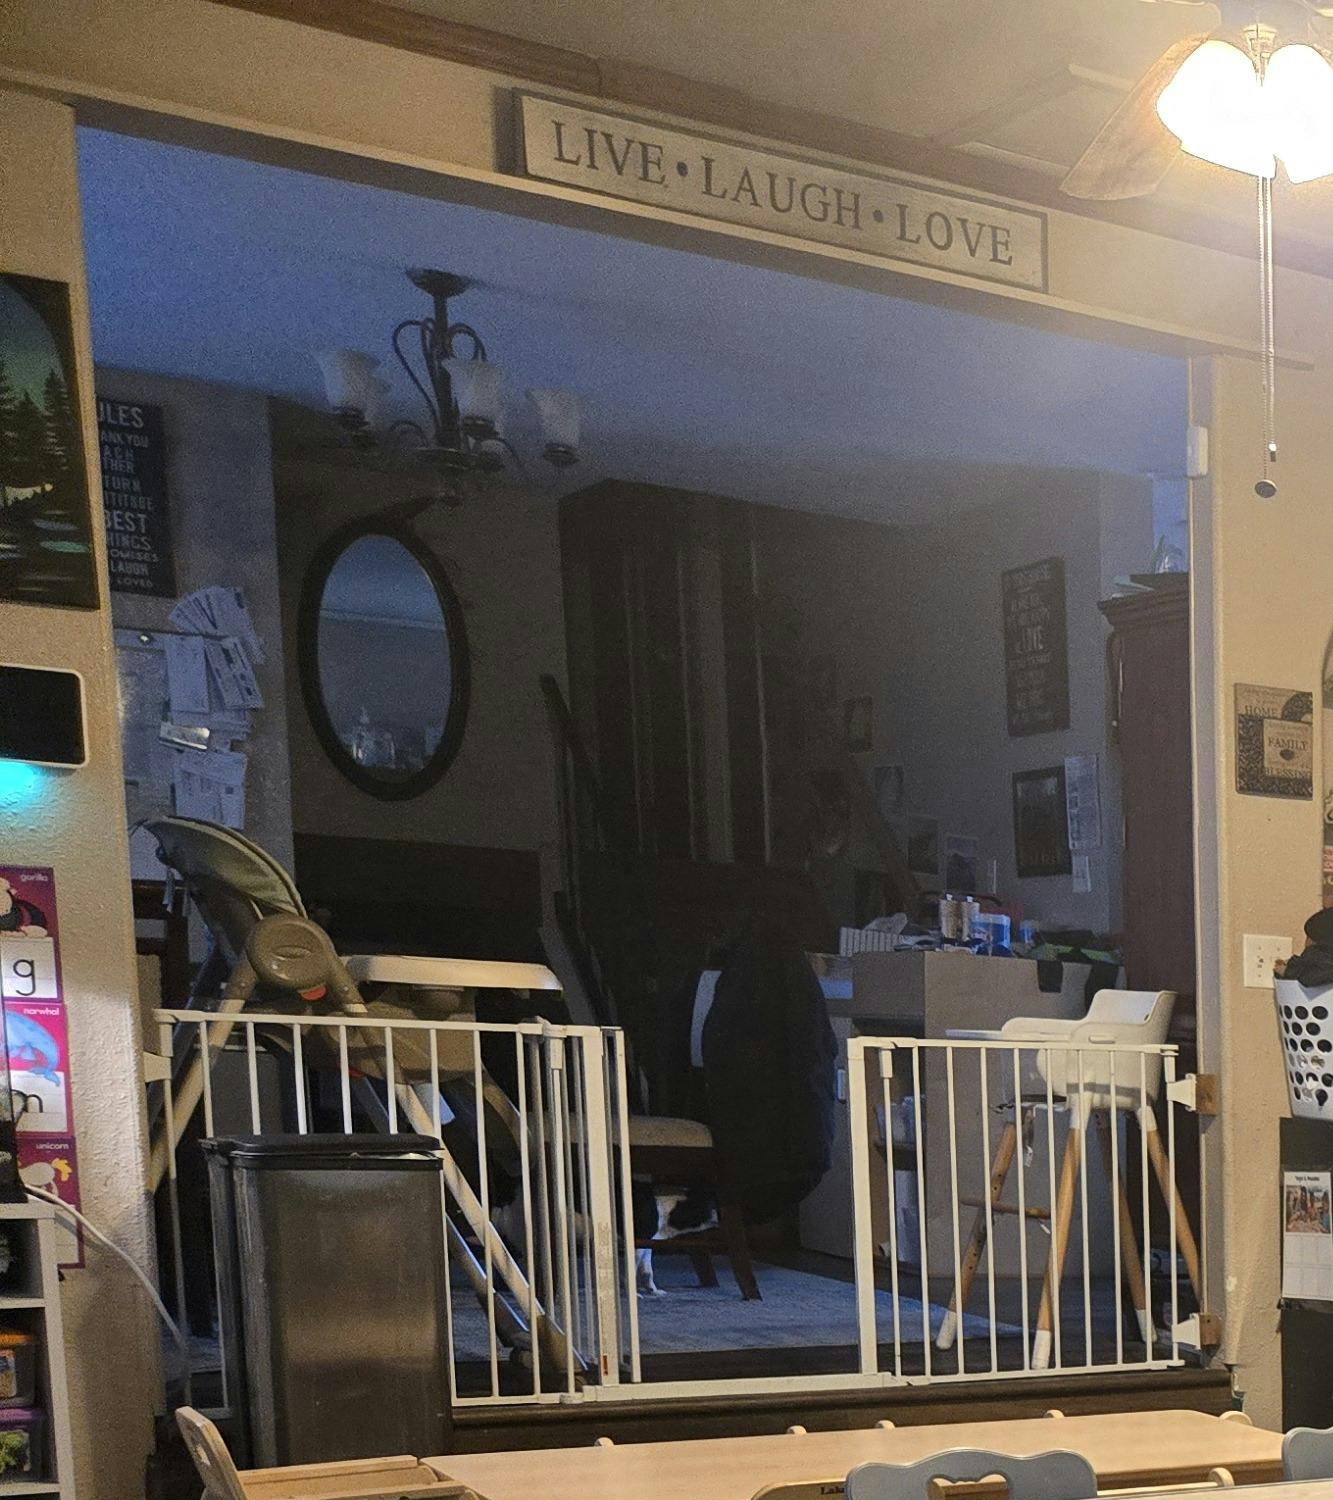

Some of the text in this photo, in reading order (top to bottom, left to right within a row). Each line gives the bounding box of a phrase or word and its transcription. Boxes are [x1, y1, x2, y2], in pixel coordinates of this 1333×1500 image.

[552, 119, 1013, 266] LIVE LAUGH LOVE
[1244, 705, 1276, 717] HOME
[1268, 736, 1307, 750] FAMILY
[20, 872, 49, 883] gorilla
[12, 957, 36, 997] g
[23, 1007, 60, 1016] narwhal
[36, 1142, 69, 1150] unicorn
